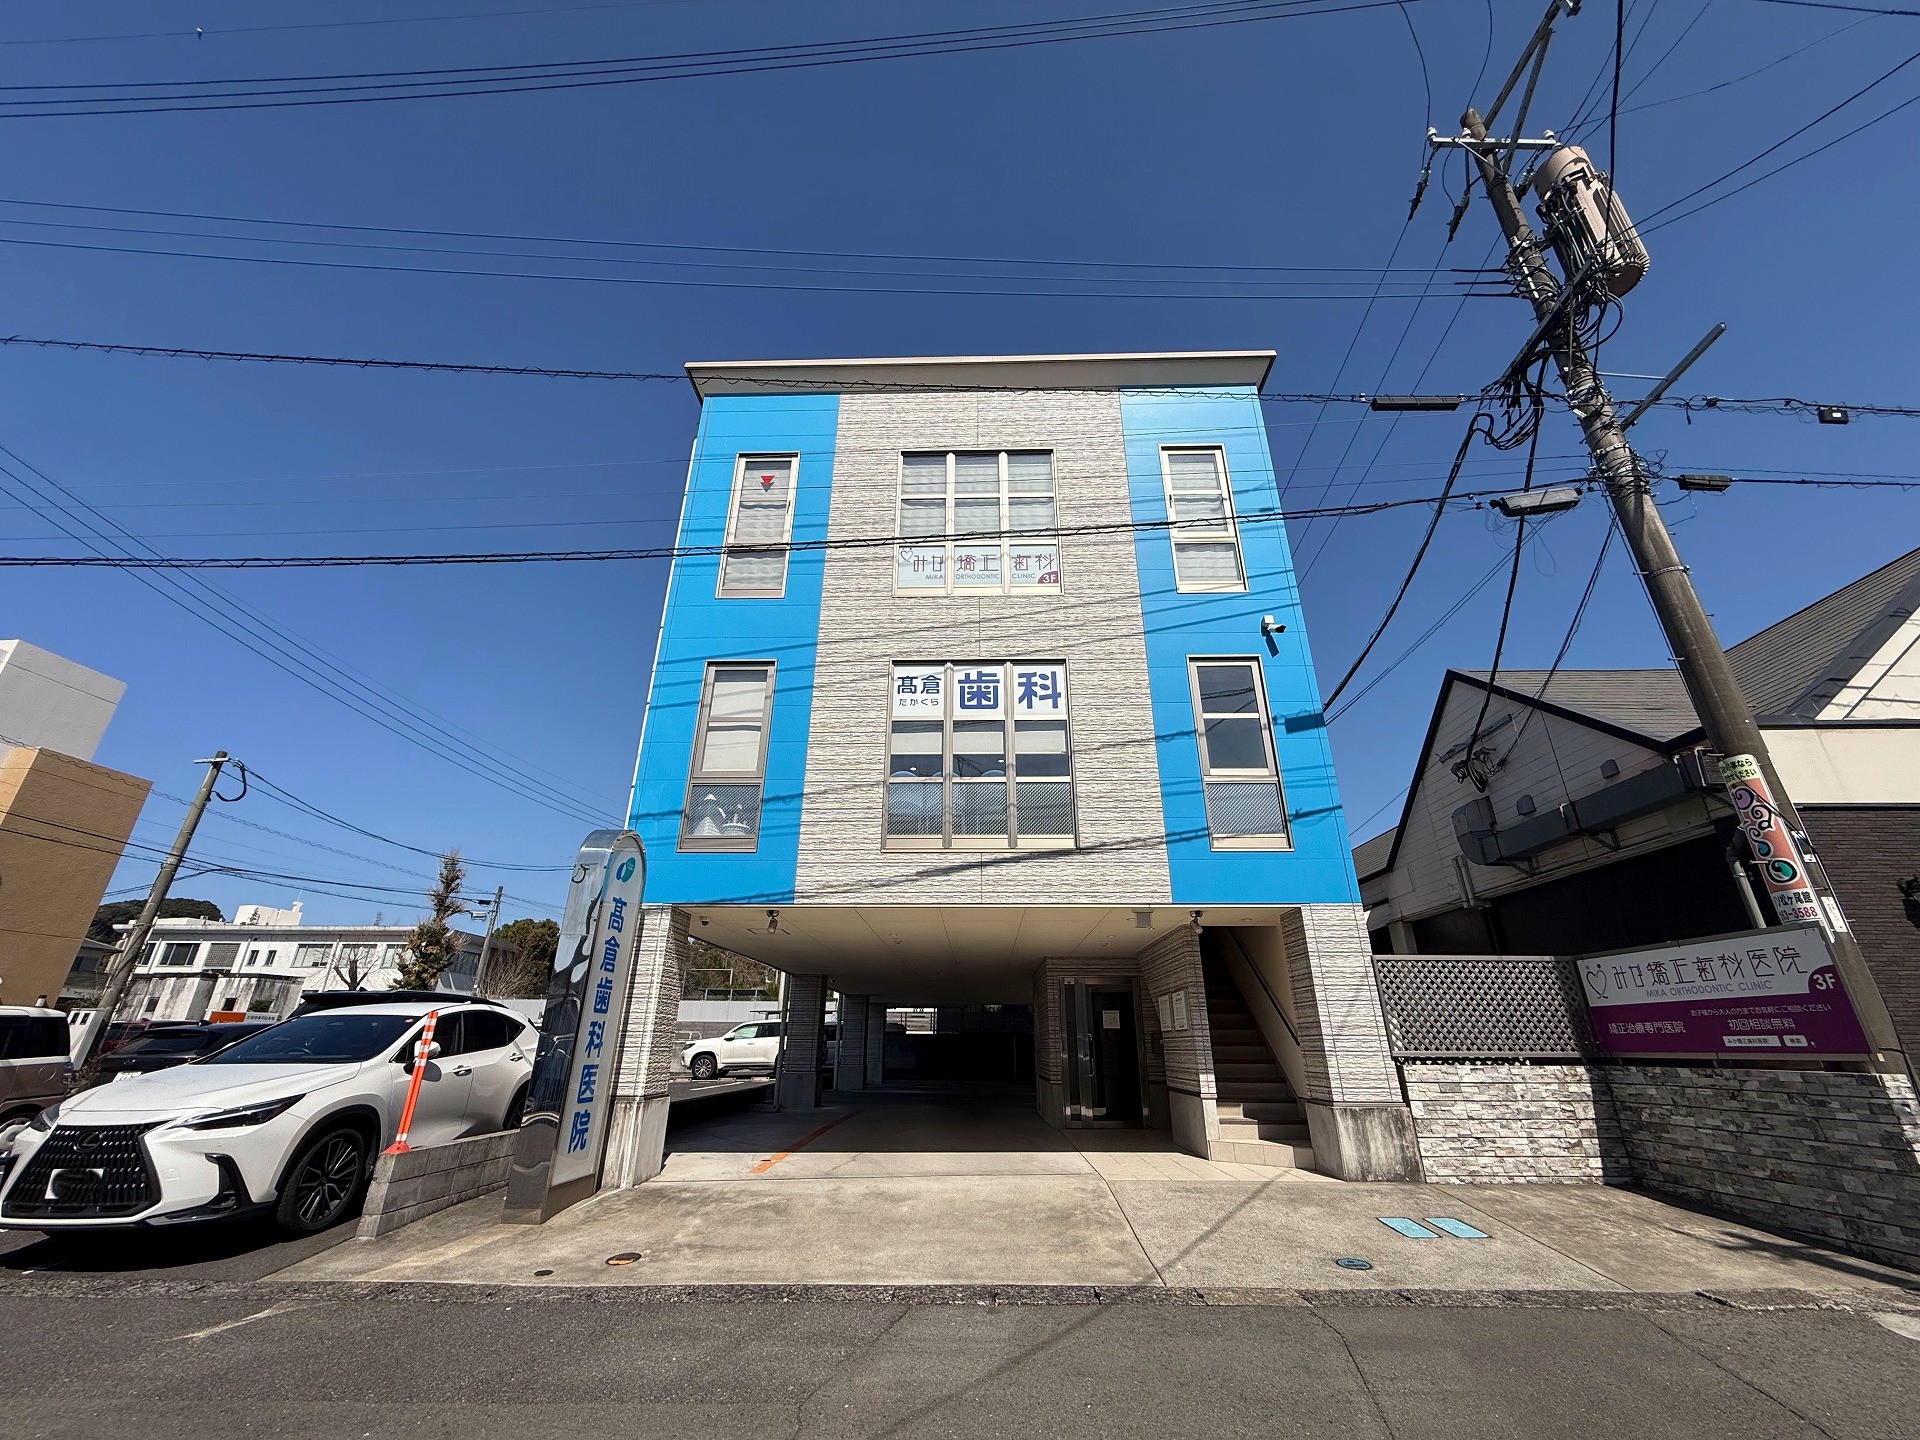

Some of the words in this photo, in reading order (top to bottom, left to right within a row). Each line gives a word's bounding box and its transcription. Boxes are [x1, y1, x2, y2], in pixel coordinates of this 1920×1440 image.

[1042, 574, 1057, 583] 3F
[957, 670, 1062, 710] 歯科
[898, 698, 939, 707] たかくら
[1612, 946, 1809, 989] みか矯正歯科医院
[1645, 988, 1667, 999] MIKA
[1669, 983, 1734, 997] ORTHODONTIC
[1738, 979, 1773, 992] CLINIC
[1812, 973, 1838, 991] 3F
[1608, 1020, 1687, 1034] 矯正治療専門医院
[1727, 1017, 1796, 1031] 初回相談無料
